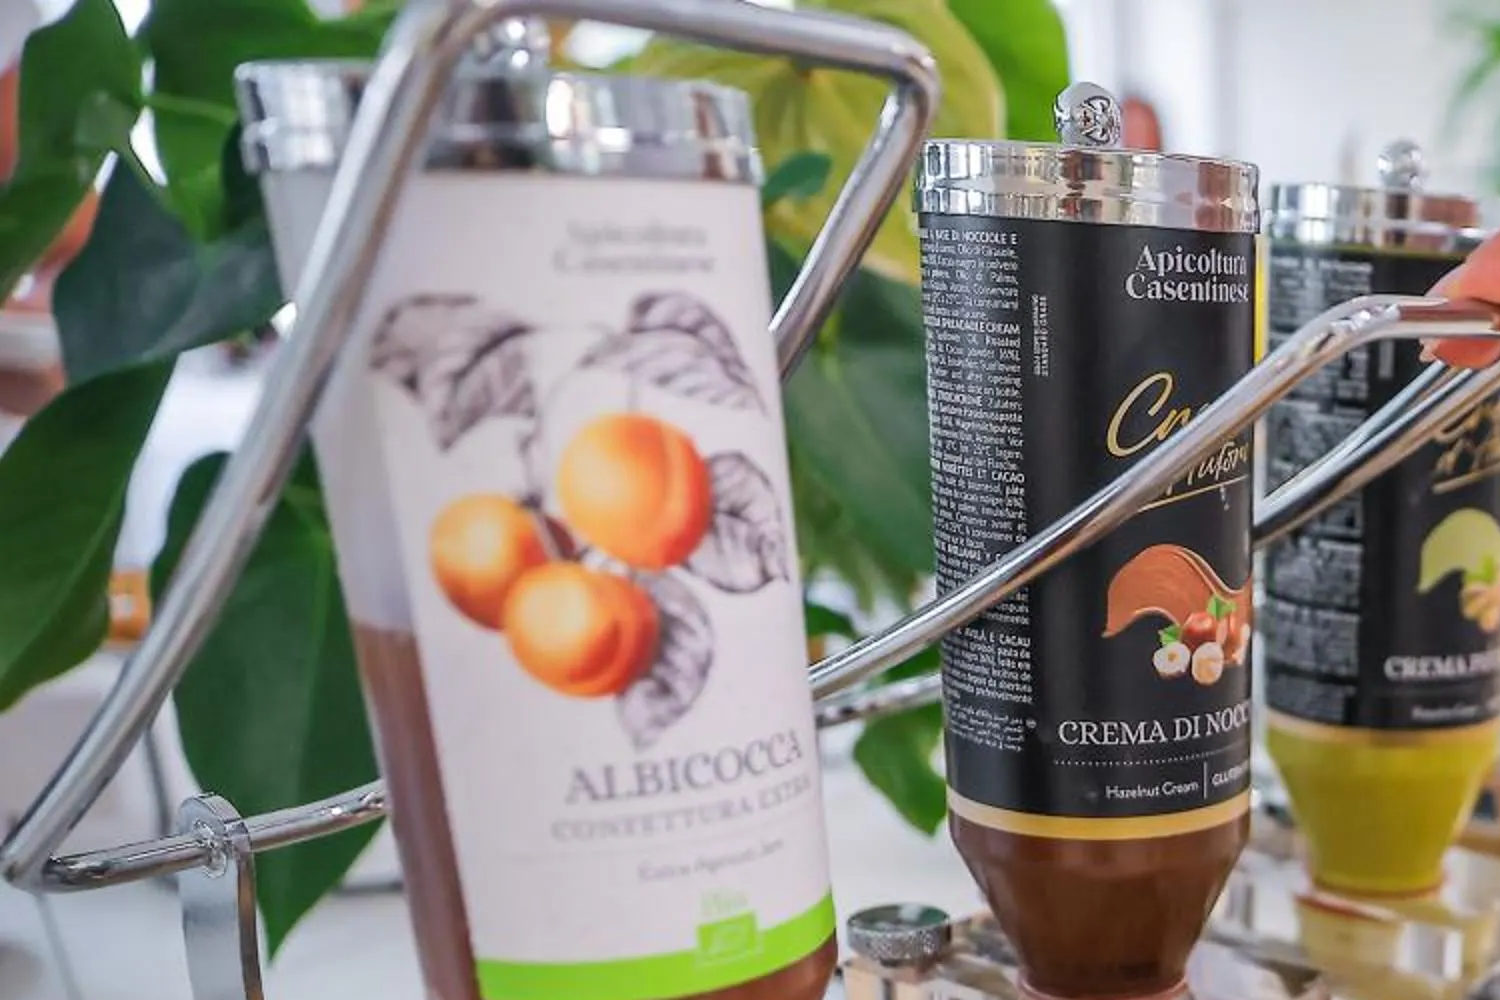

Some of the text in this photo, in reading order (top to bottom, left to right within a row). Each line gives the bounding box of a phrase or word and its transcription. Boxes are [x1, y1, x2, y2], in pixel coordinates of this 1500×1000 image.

[1135, 244, 1248, 277] Apicoltura
[1125, 271, 1249, 303] Casentinese
[1058, 720, 1168, 745] CREMA
[1172, 715, 1201, 741] DI
[564, 730, 802, 805] ALBICOCCA
[1106, 781, 1199, 799] Hazelnut Cream
